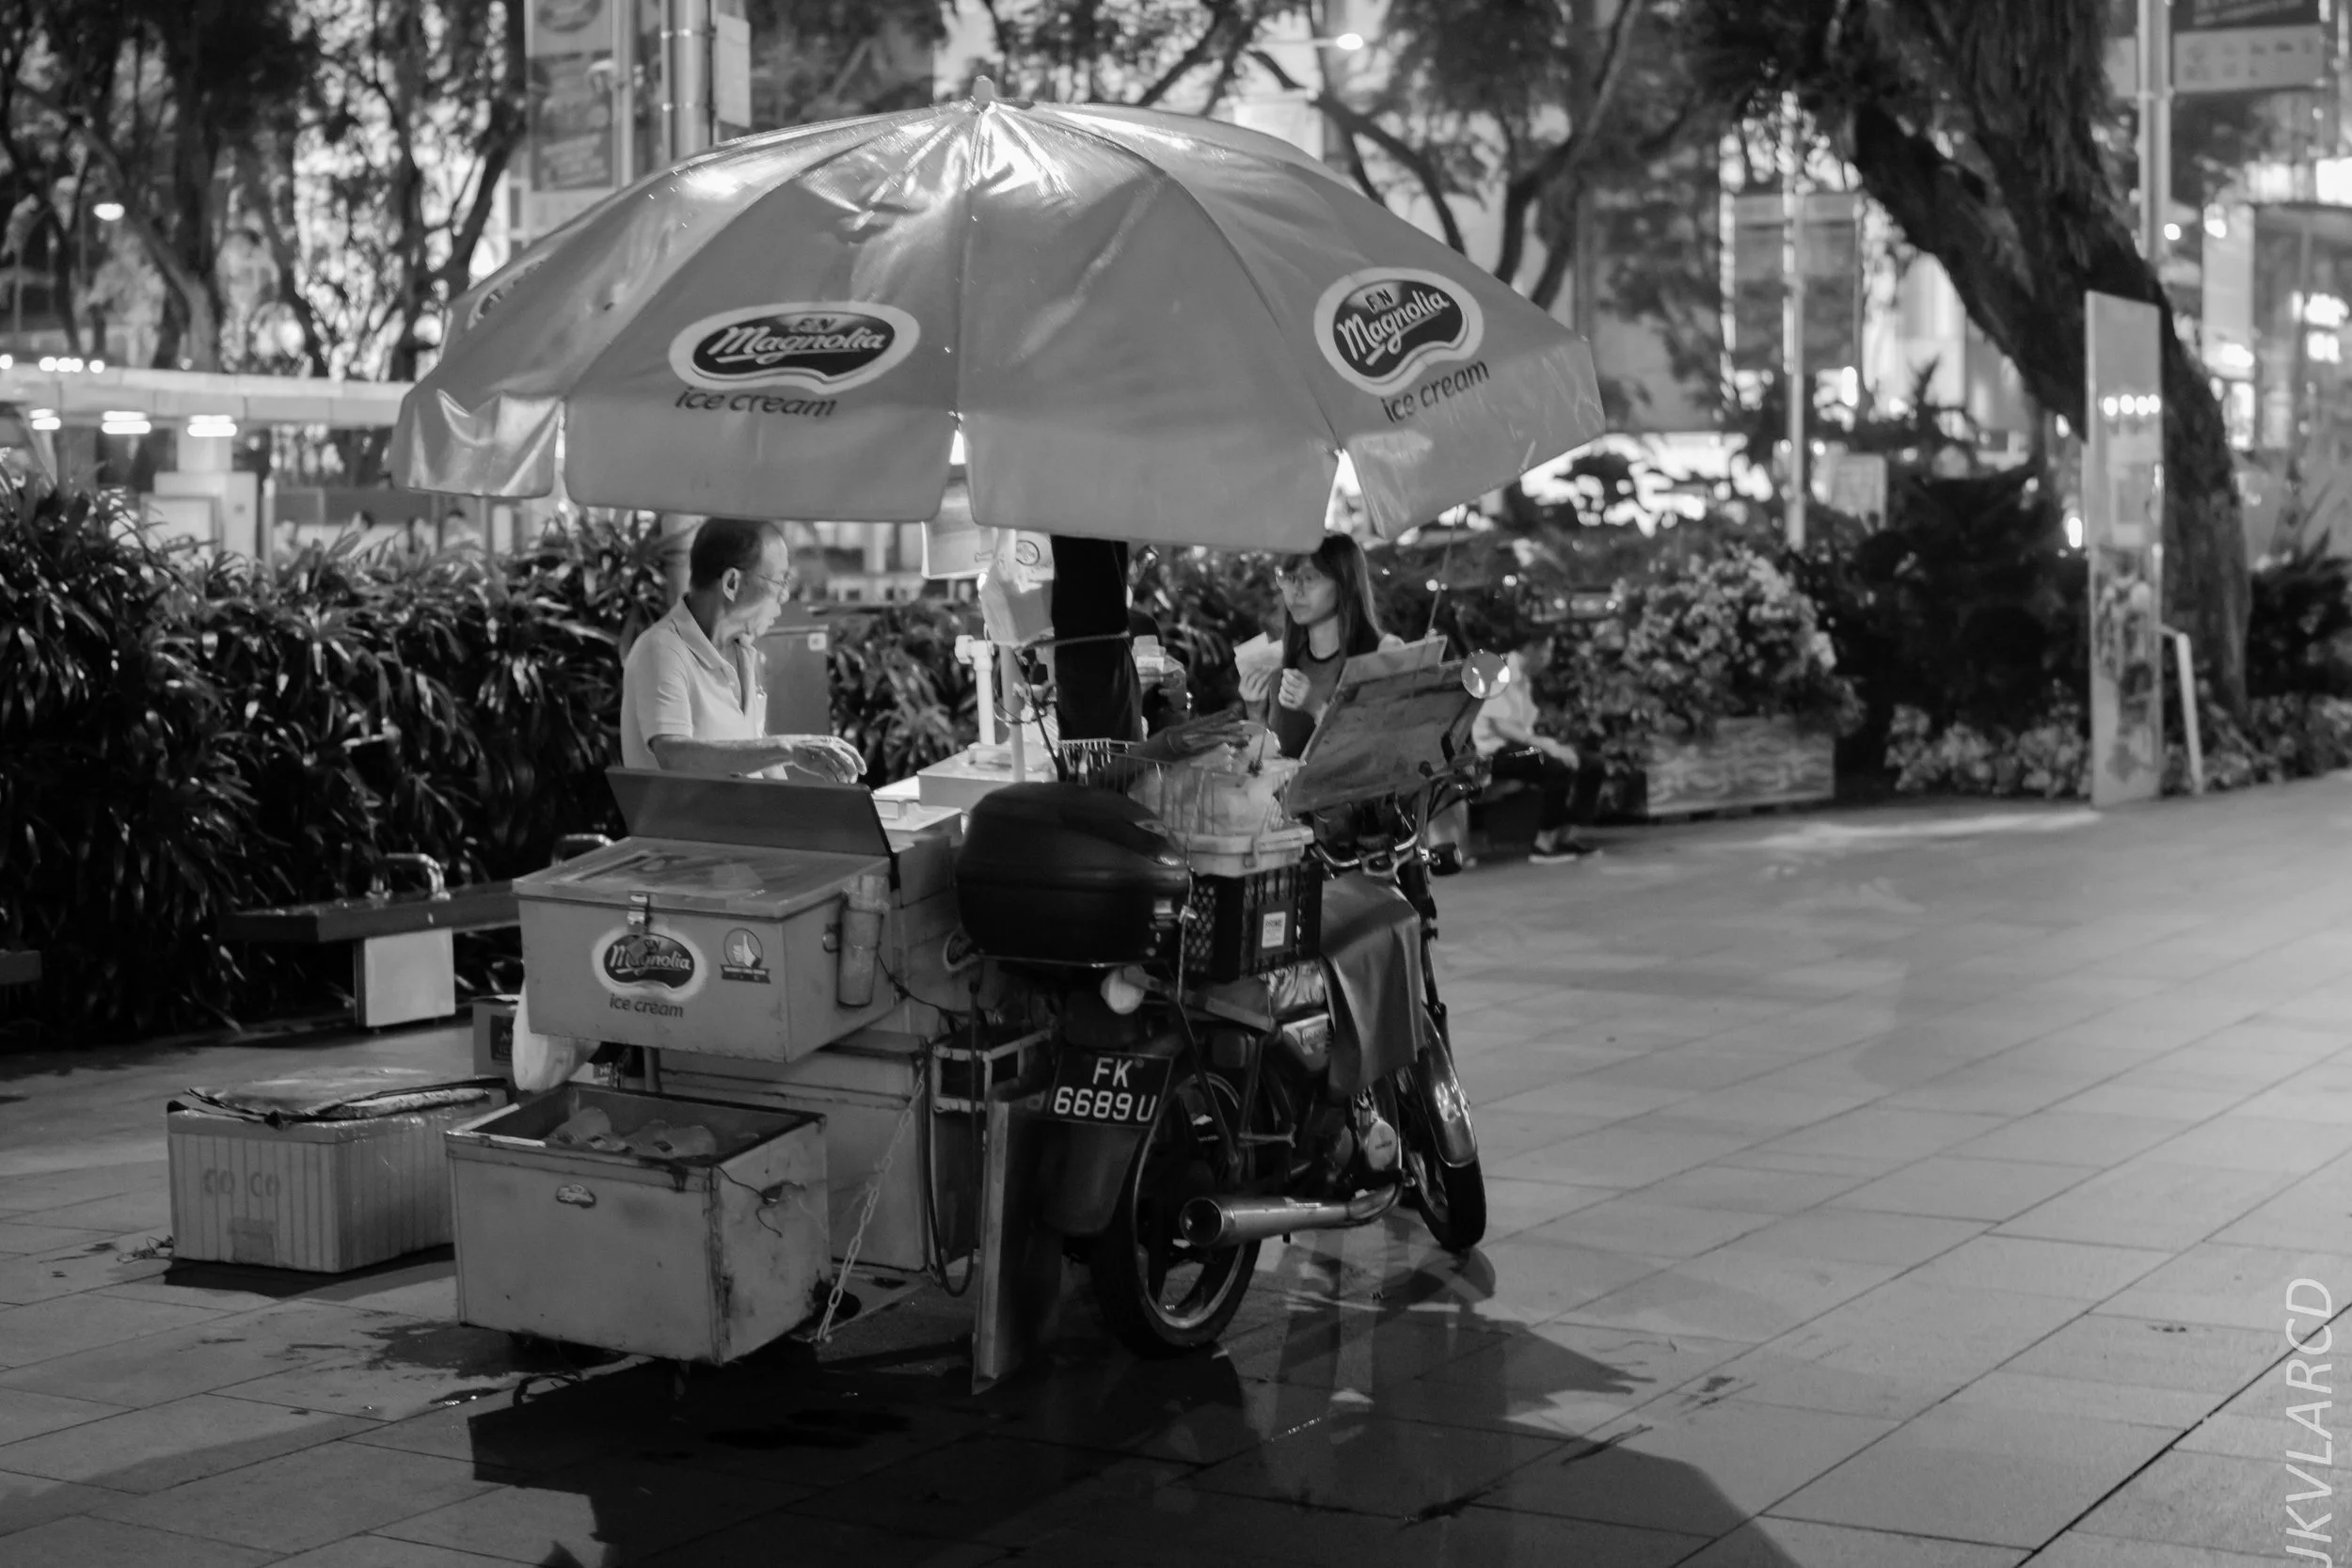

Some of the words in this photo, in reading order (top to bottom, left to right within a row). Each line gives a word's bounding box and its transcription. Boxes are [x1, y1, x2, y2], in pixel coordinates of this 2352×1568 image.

[707, 326, 885, 364] Magnolia
[1336, 290, 1451, 366] Magnolia
[675, 387, 725, 410] ice
[728, 393, 837, 417] cream
[1380, 394, 1415, 423] ice
[1420, 360, 1490, 407] cream
[610, 994, 630, 1010] ice
[634, 999, 684, 1018] cream
[1092, 1057, 1133, 1087] FK
[1054, 1086, 1133, 1120] 6689
[1136, 1095, 1157, 1121] U
